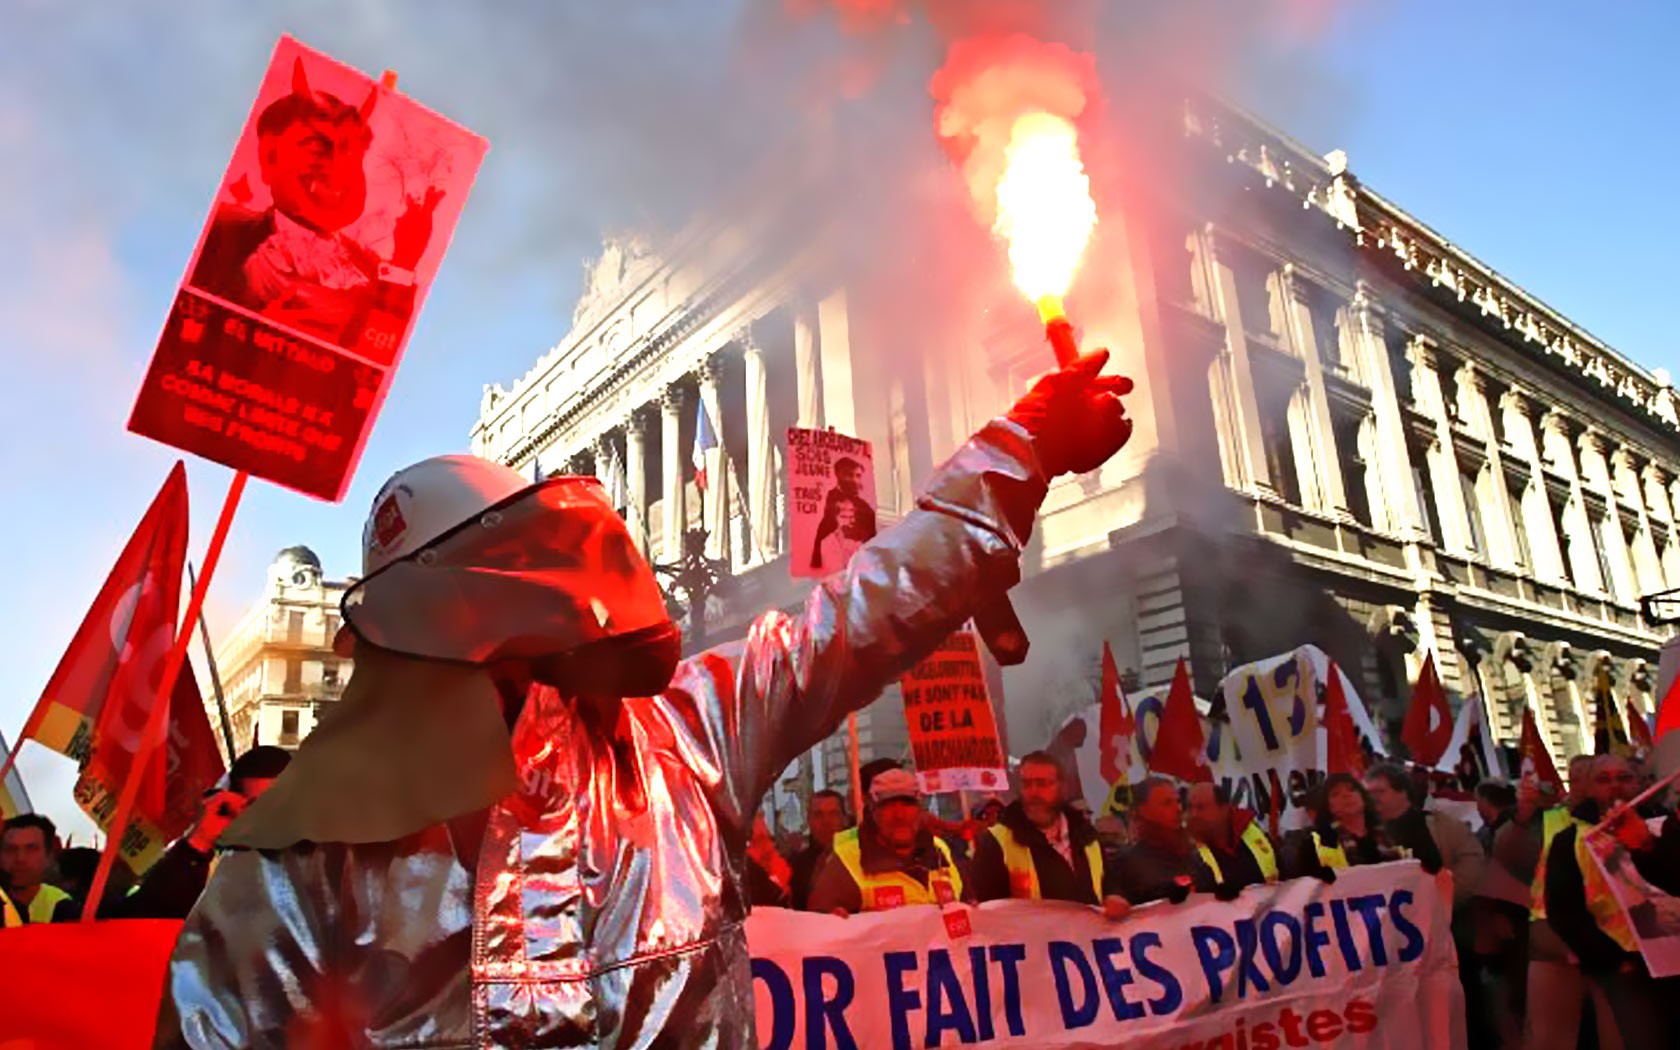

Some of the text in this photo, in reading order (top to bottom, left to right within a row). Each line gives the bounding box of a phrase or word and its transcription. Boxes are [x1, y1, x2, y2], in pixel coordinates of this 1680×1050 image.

[920, 708, 973, 733] DE LA
[884, 944, 1026, 1050] FAIT
[1048, 932, 1183, 1029] DES
[1191, 890, 1424, 1003] PROFITS
